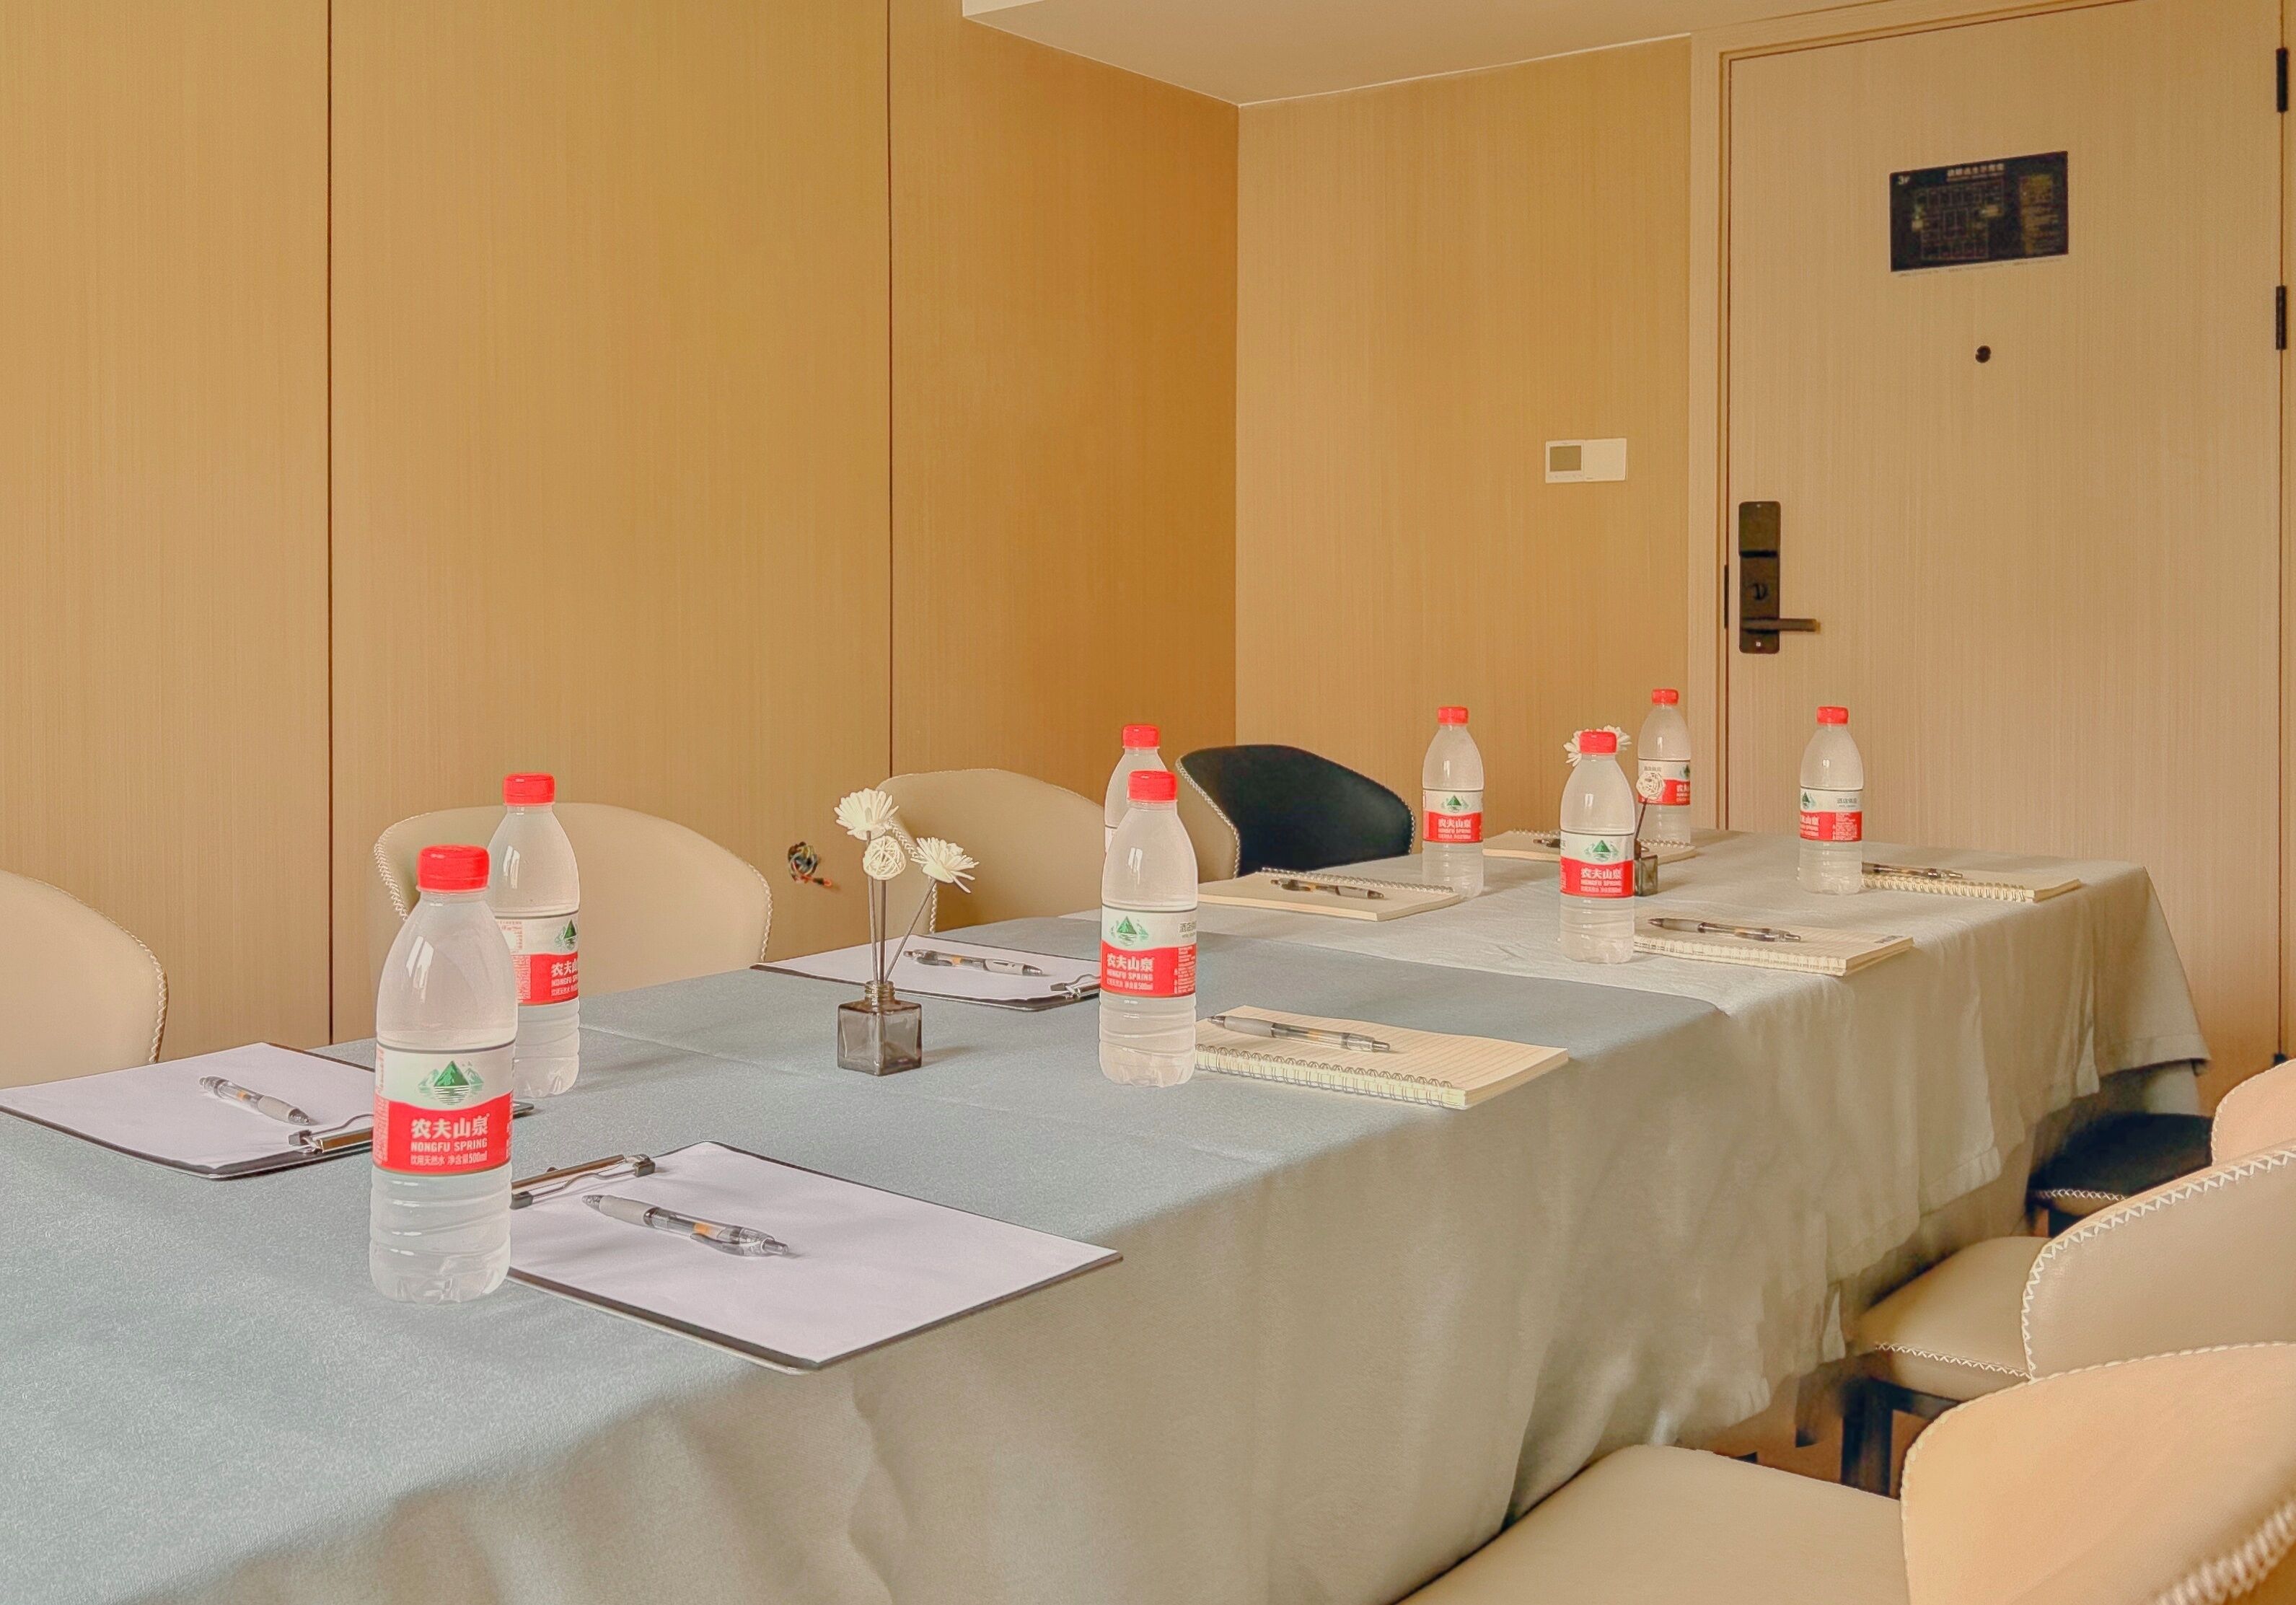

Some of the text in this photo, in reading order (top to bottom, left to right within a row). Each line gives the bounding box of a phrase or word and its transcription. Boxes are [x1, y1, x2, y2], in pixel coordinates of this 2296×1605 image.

[551, 959, 578, 977] 农夫山
[1106, 953, 1155, 972] 农夫山泉
[410, 1114, 488, 1139] 农夫山泉
[410, 1138, 488, 1153] NONGFU SPRING
